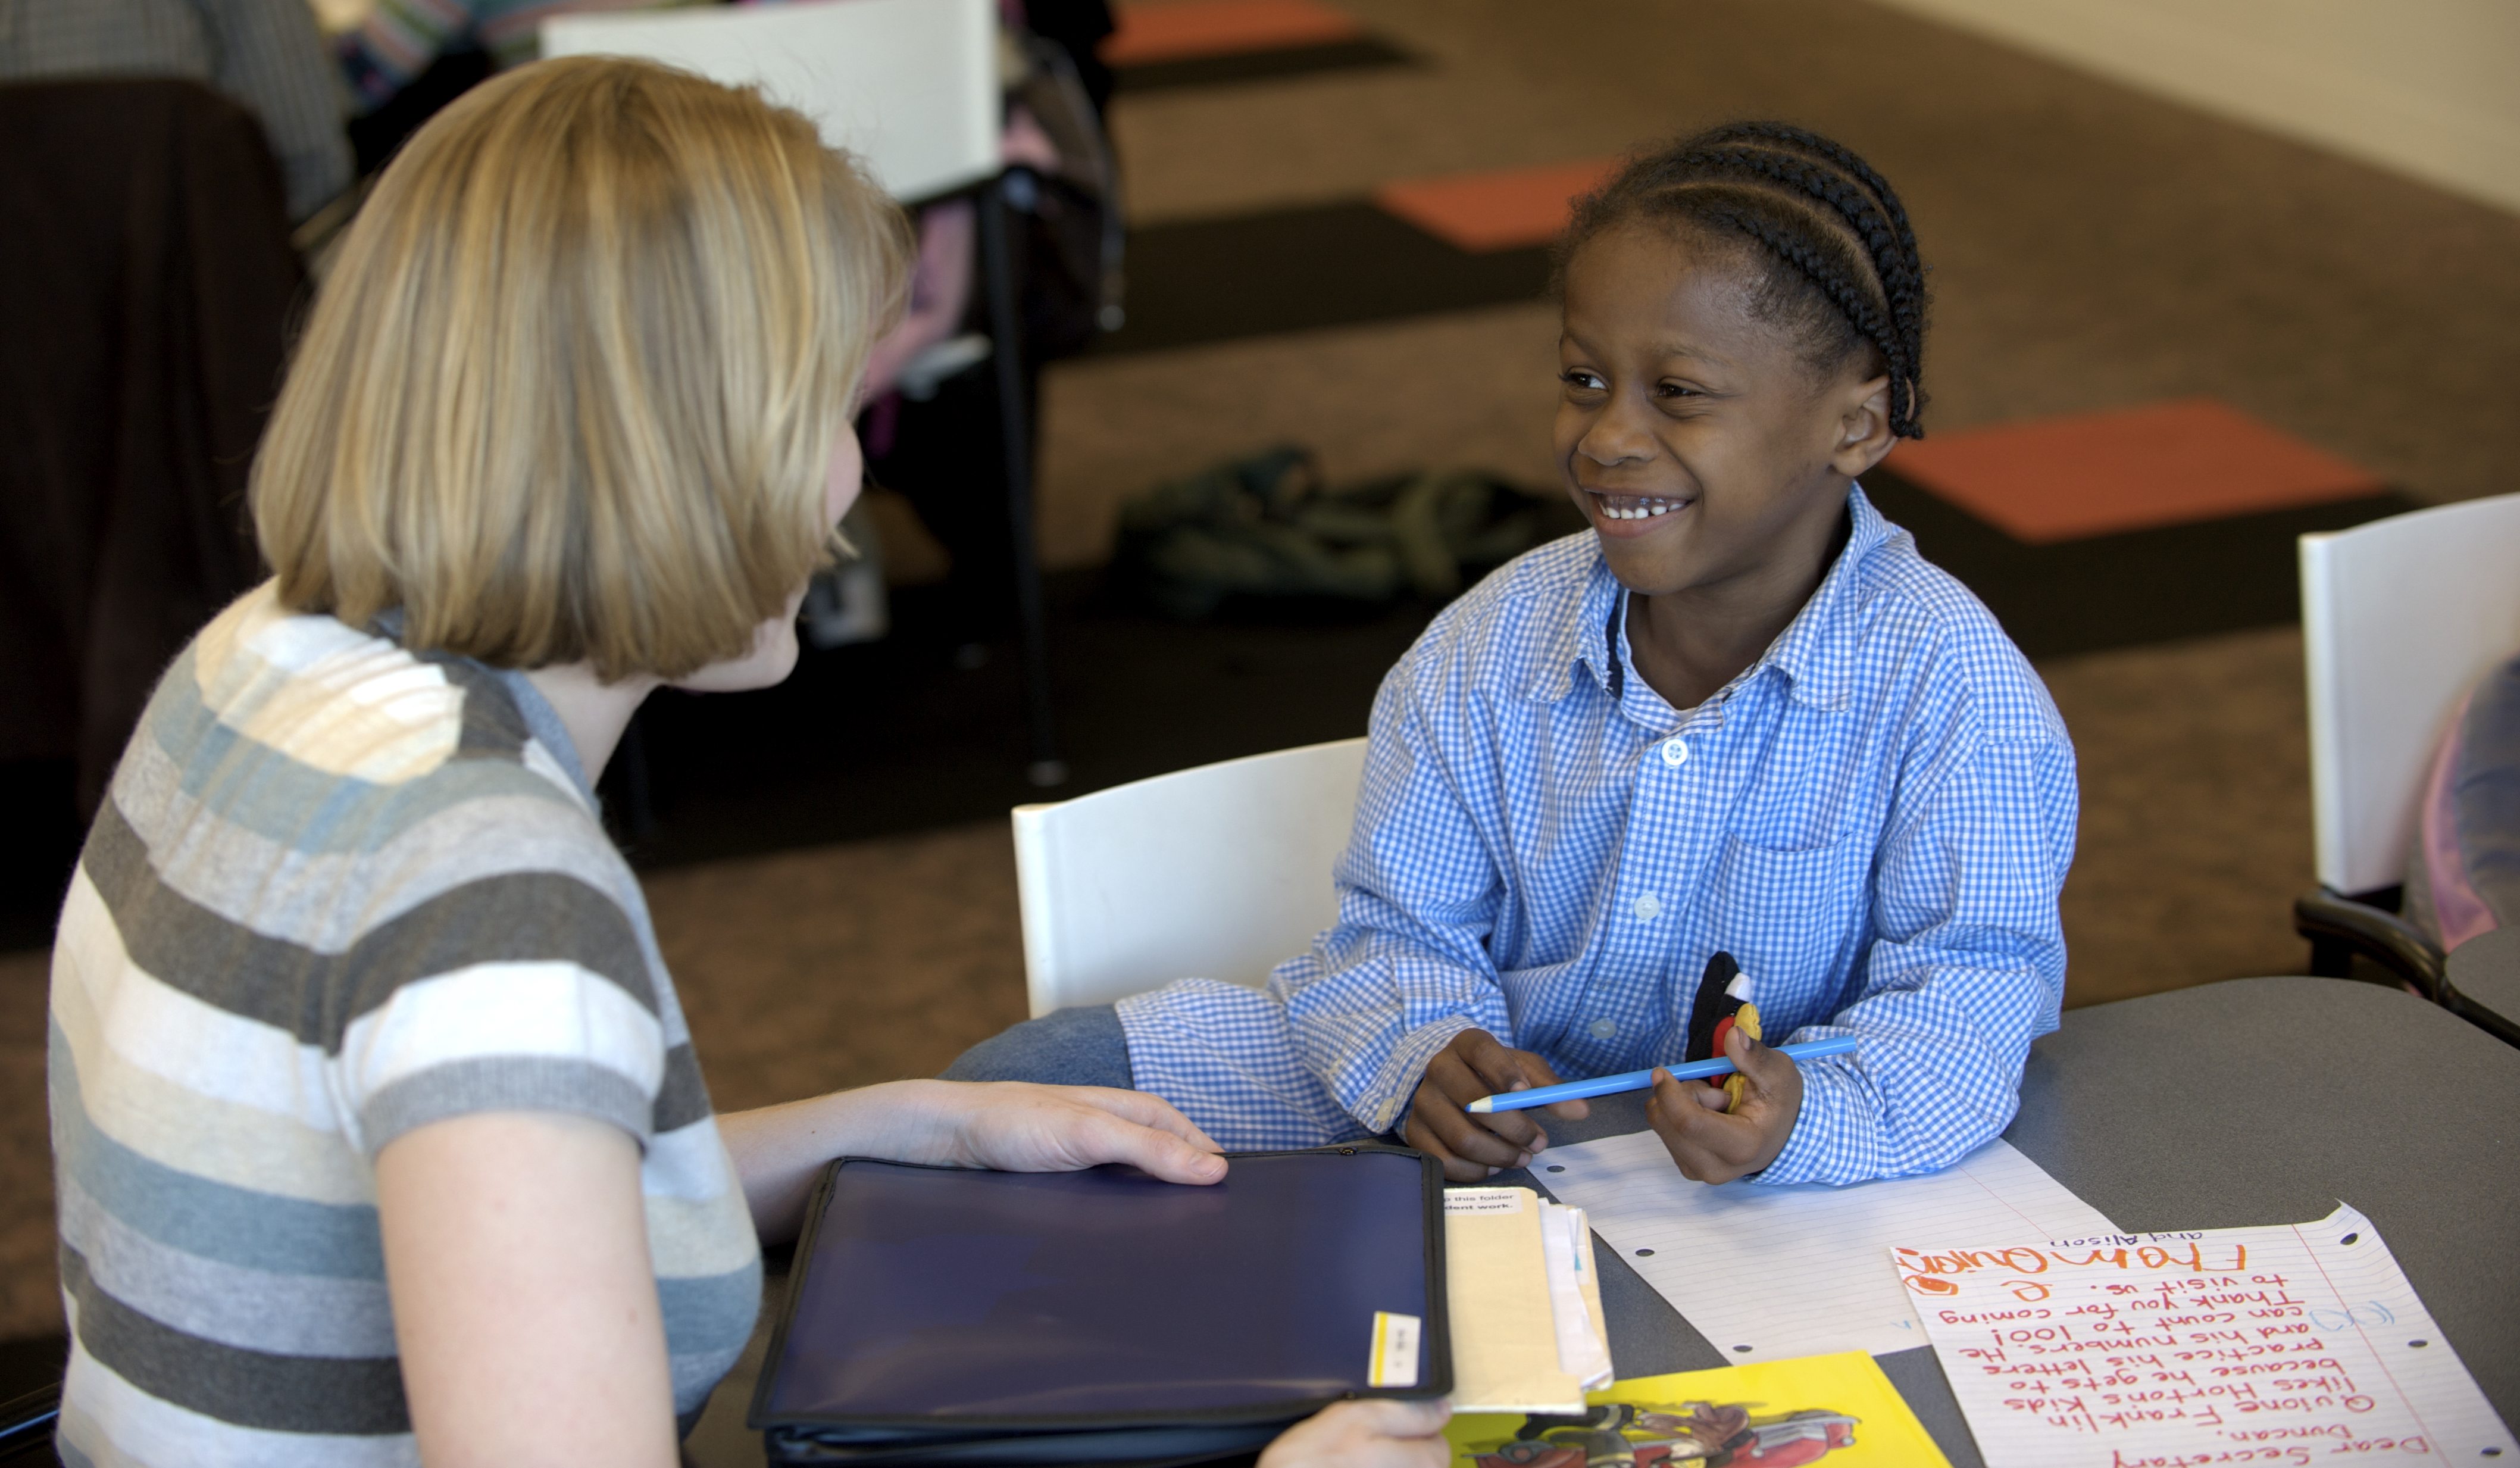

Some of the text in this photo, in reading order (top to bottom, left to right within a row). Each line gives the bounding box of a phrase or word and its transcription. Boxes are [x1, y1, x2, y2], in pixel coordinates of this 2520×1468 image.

[2050, 1232, 2203, 1247] and Alison
[2090, 1275, 2288, 1295] to visit us.
[2065, 1303, 2119, 1320] for
[2189, 1291, 2305, 1310] Thank
[1939, 1310, 2051, 1324] coming
[1991, 1307, 2303, 1346] can count to 100!
[1959, 1323, 2309, 1363] and his numbers. He
[1982, 1338, 2324, 1376] practice his letters
[2010, 1358, 2346, 1395] because he gets to
[2272, 1376, 2355, 1393] likes
[2047, 1395, 2375, 1434] Quione Franklin
[2113, 1436, 2430, 1468] Dear Secretary
